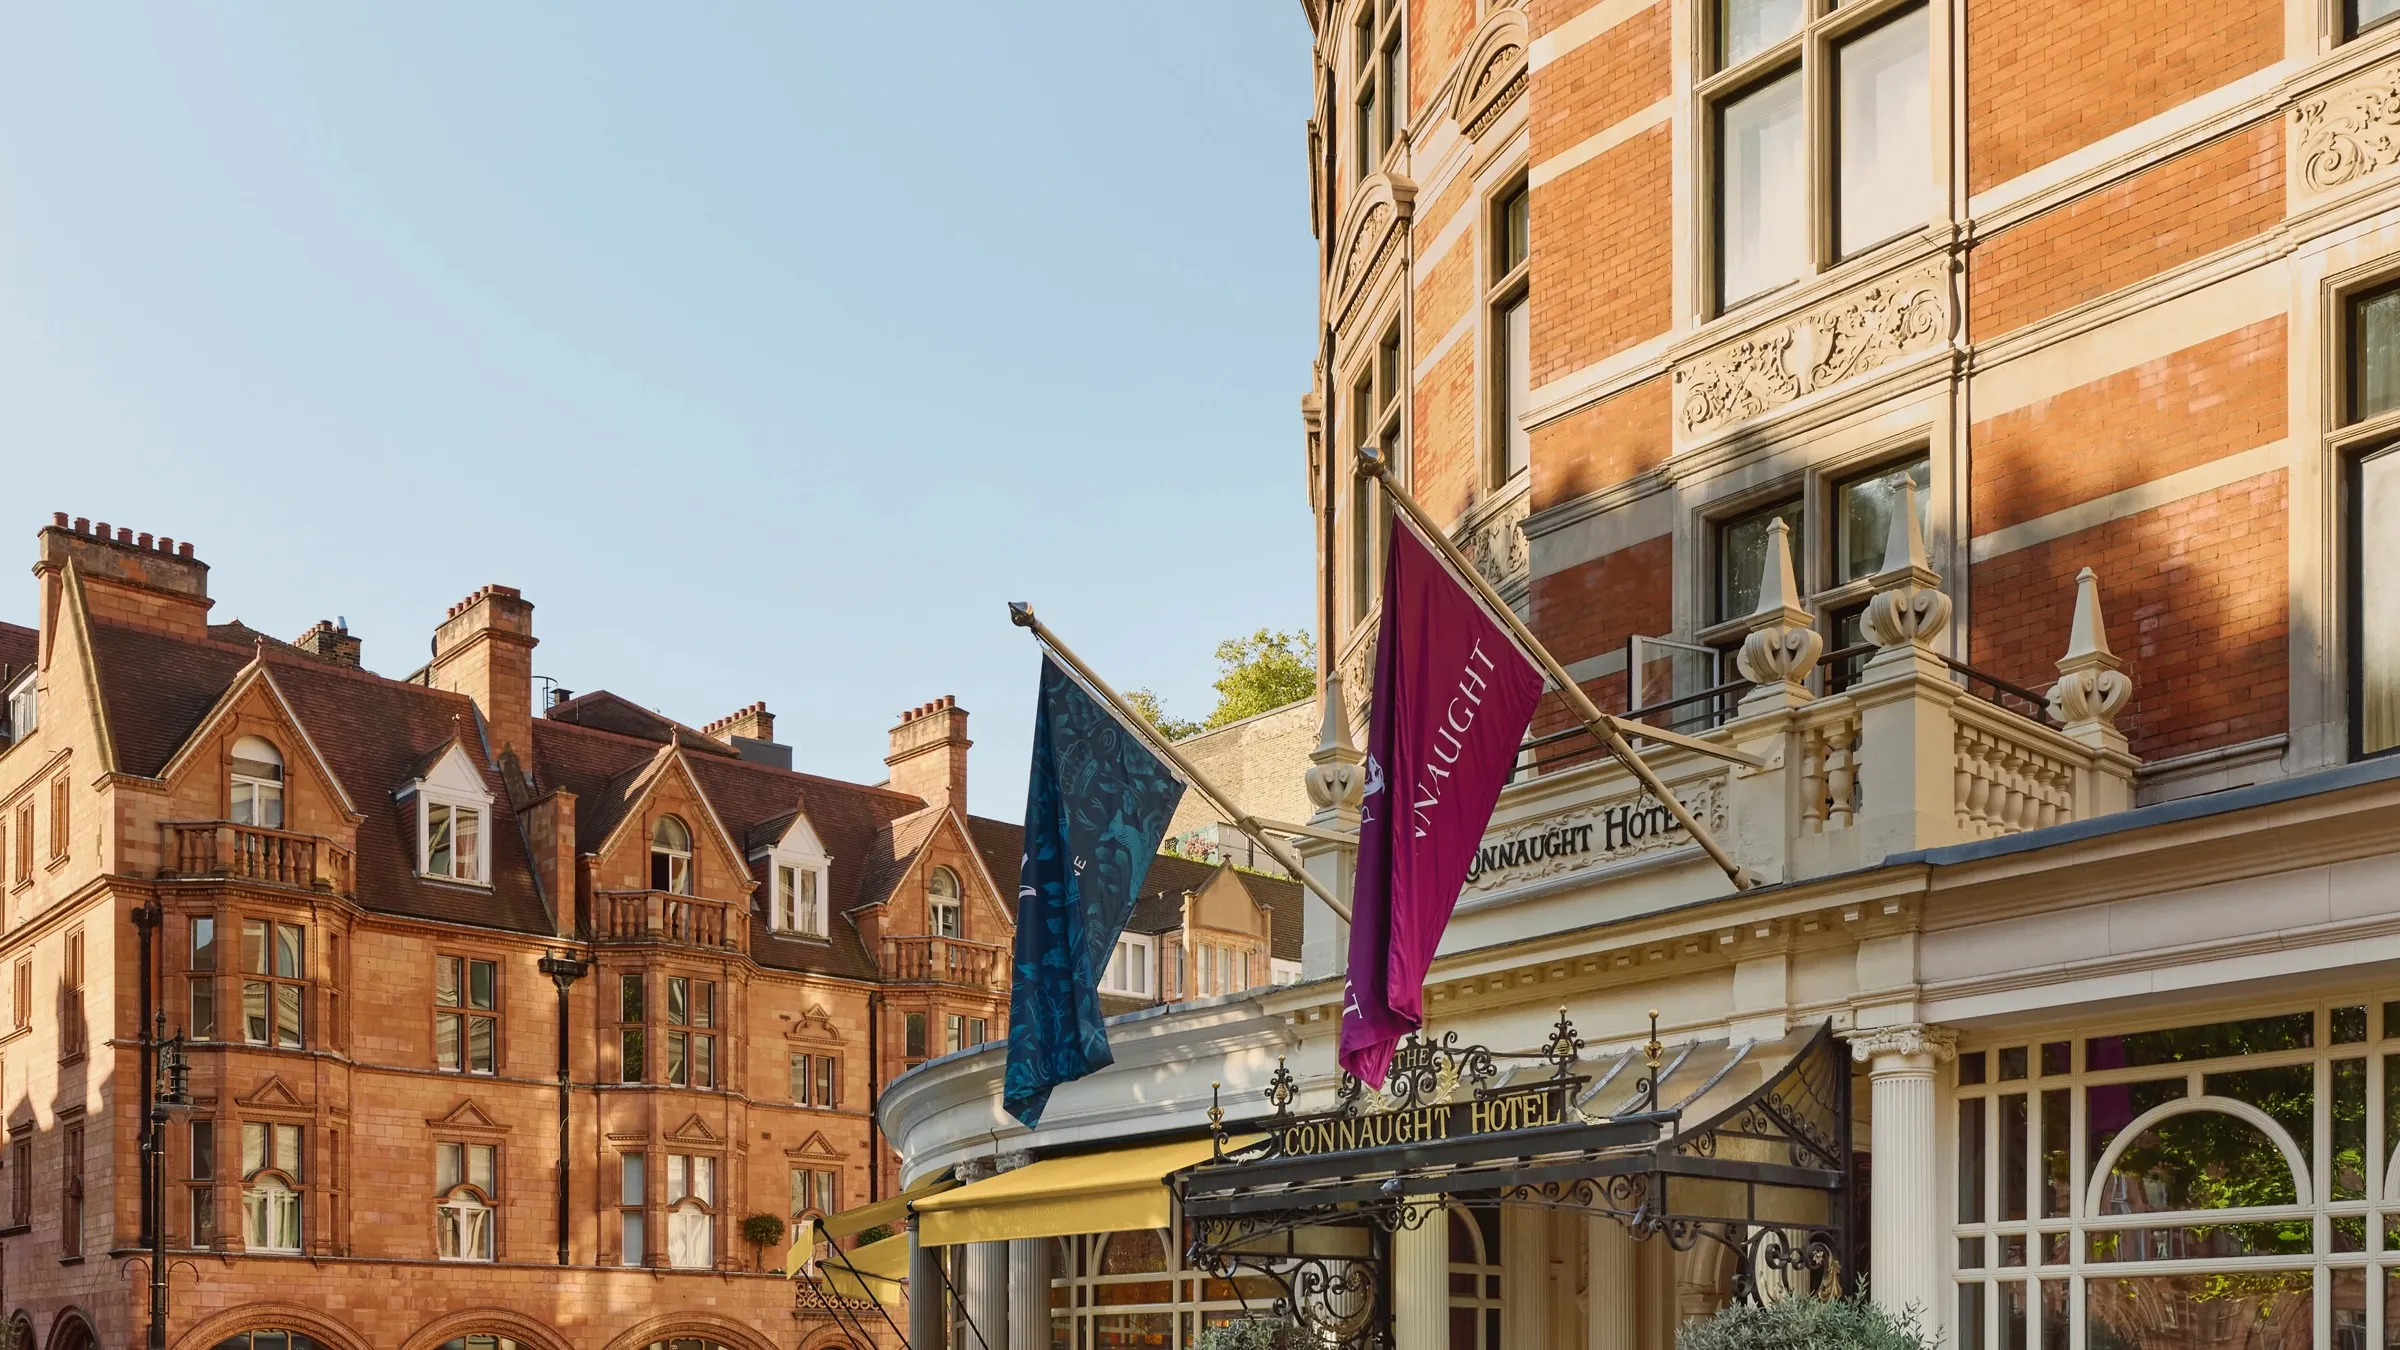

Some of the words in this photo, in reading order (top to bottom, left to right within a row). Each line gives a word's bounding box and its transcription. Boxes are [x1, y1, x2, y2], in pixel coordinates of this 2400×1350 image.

[1464, 823, 1593, 883] ONNAUGHT
[1394, 1048, 1430, 1069] THE
[1285, 1105, 1451, 1157] CONNAUGHT
[1471, 1092, 1562, 1135] HOTEL
